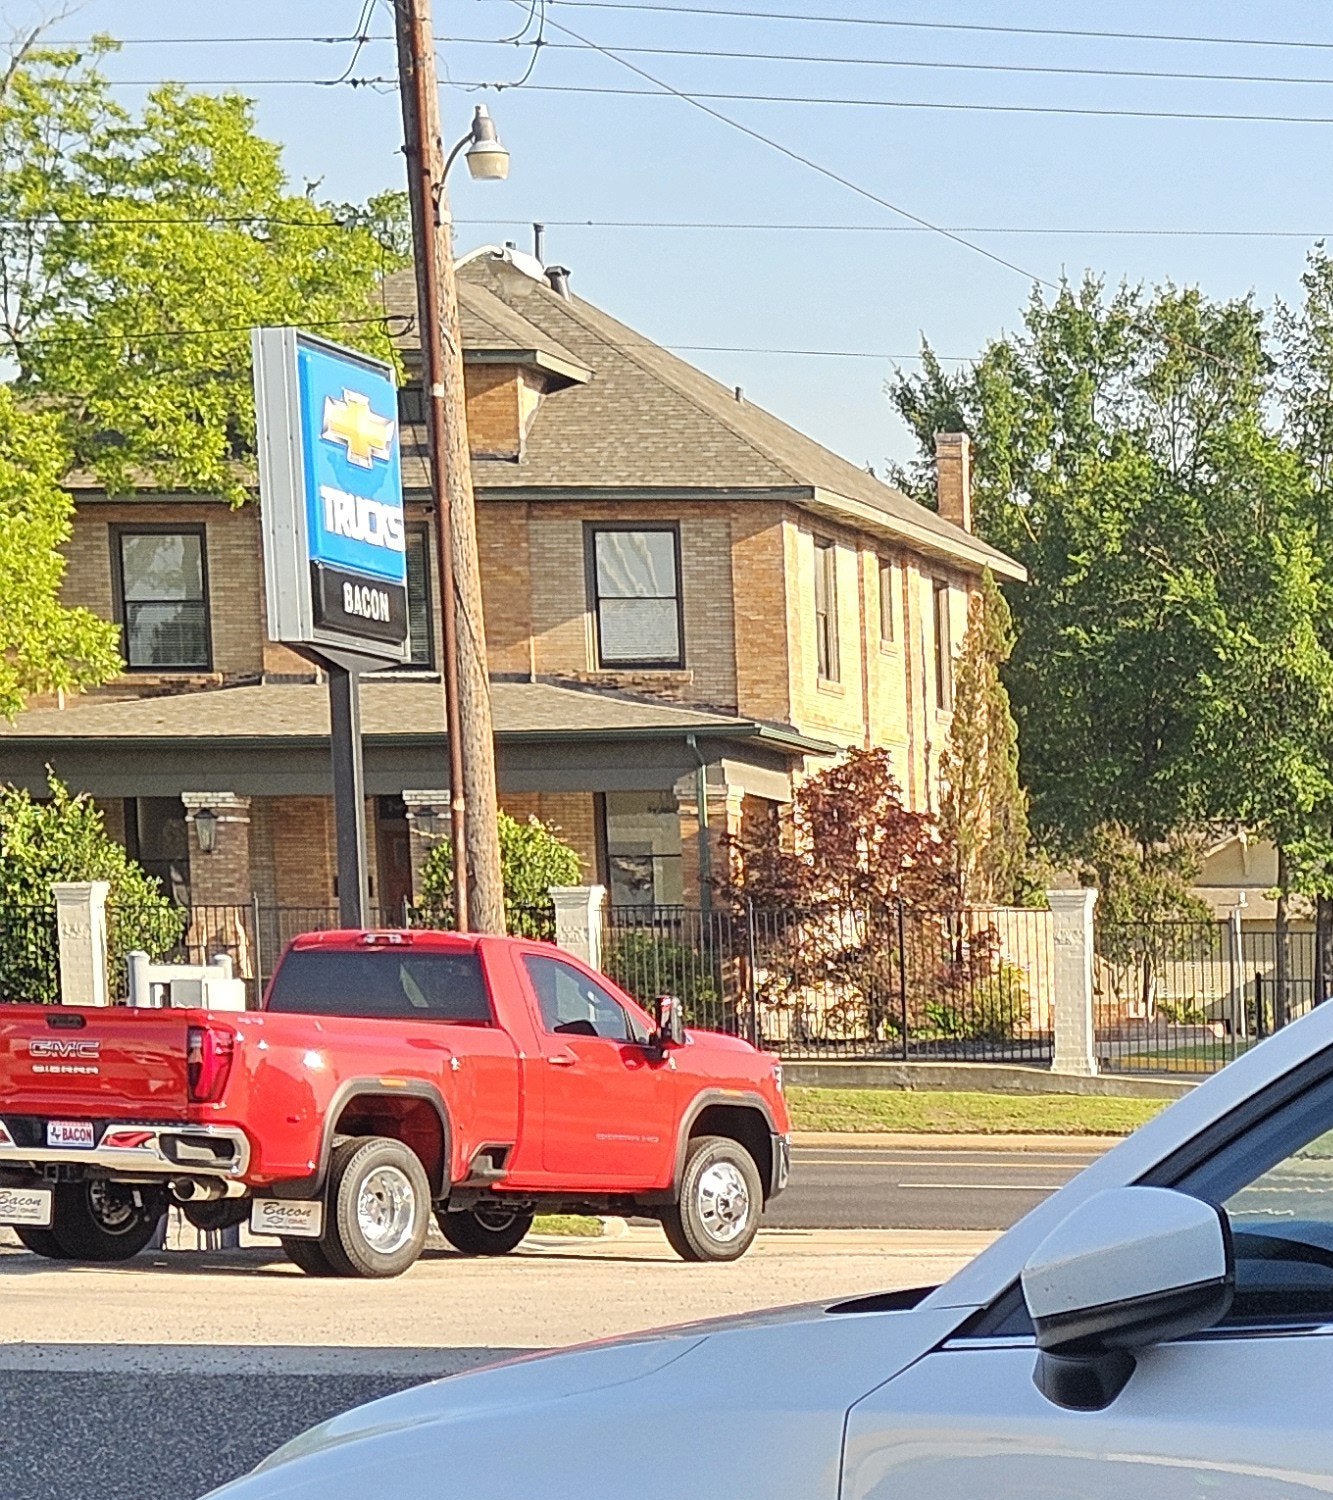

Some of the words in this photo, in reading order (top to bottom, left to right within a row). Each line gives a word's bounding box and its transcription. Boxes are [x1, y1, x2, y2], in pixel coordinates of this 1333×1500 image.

[320, 484, 405, 553] TRUCKS
[342, 581, 390, 623] BACON
[30, 1040, 100, 1059] GMC
[62, 1127, 92, 1142] BACON
[262, 1201, 312, 1217] Bacon
